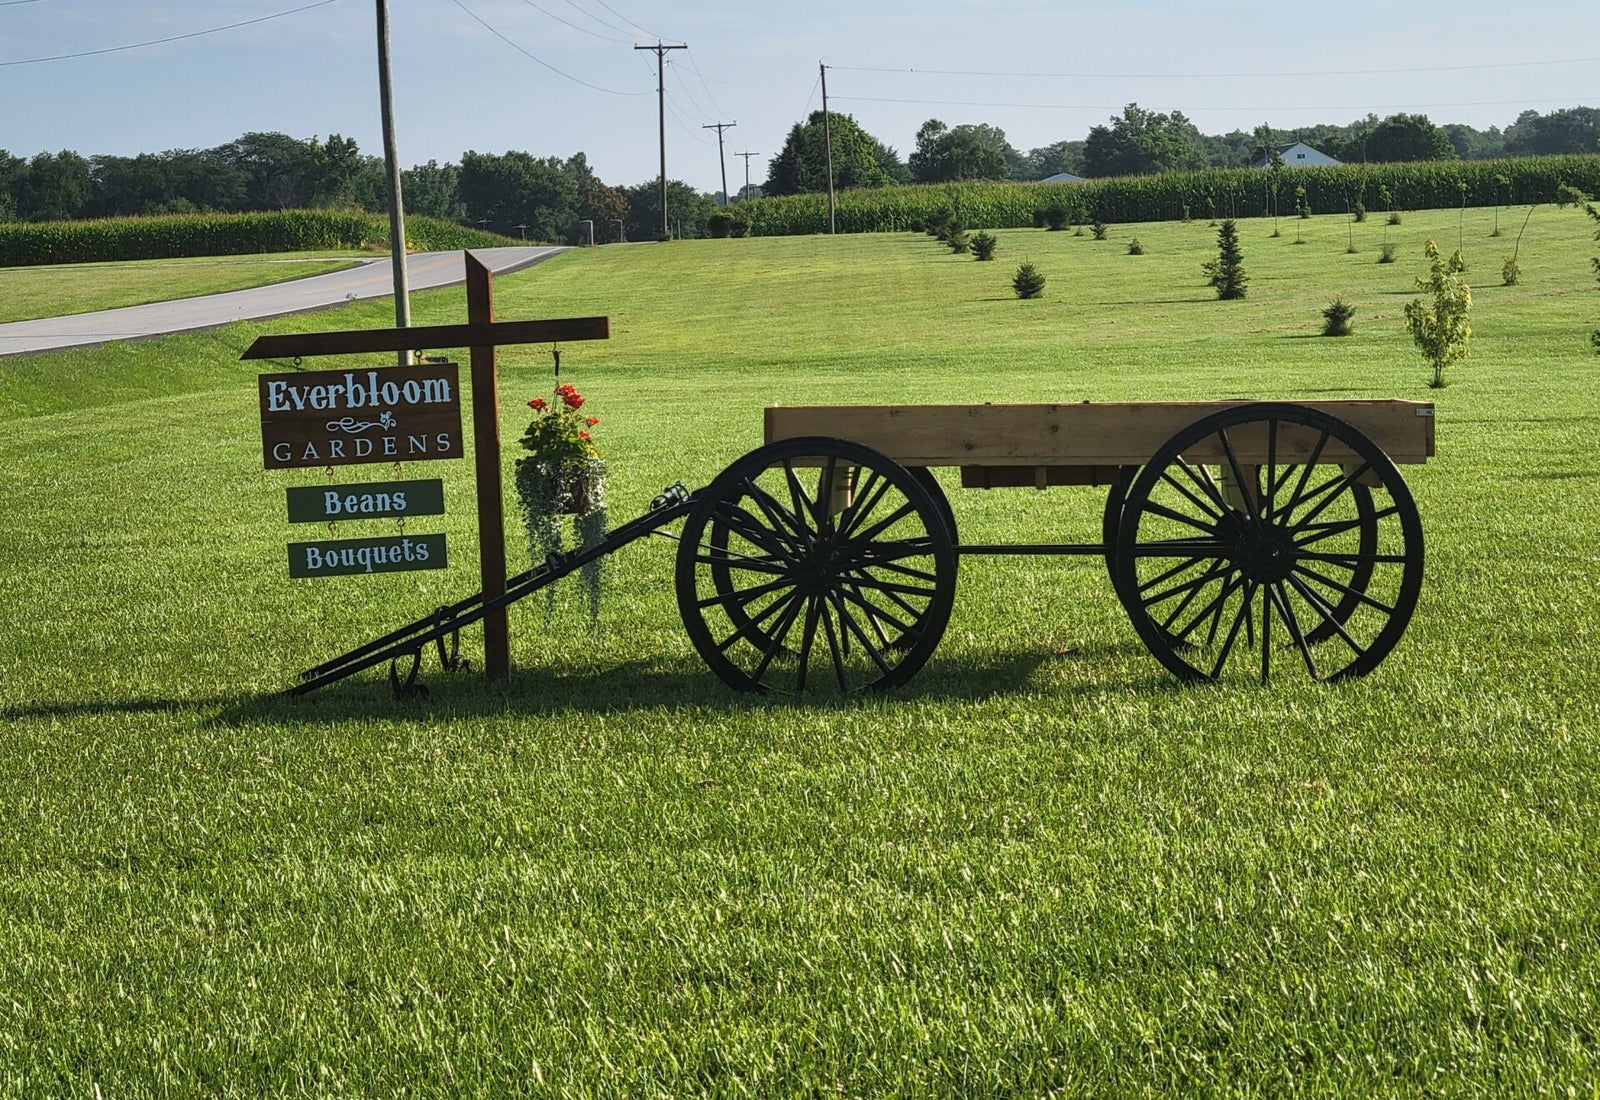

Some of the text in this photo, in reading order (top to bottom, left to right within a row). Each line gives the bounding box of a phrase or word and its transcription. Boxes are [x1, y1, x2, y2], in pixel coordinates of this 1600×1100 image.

[267, 371, 452, 412] Everbloom
[272, 433, 451, 461] GARDENS
[324, 491, 407, 515] Beans
[306, 538, 430, 573] Bouquets
